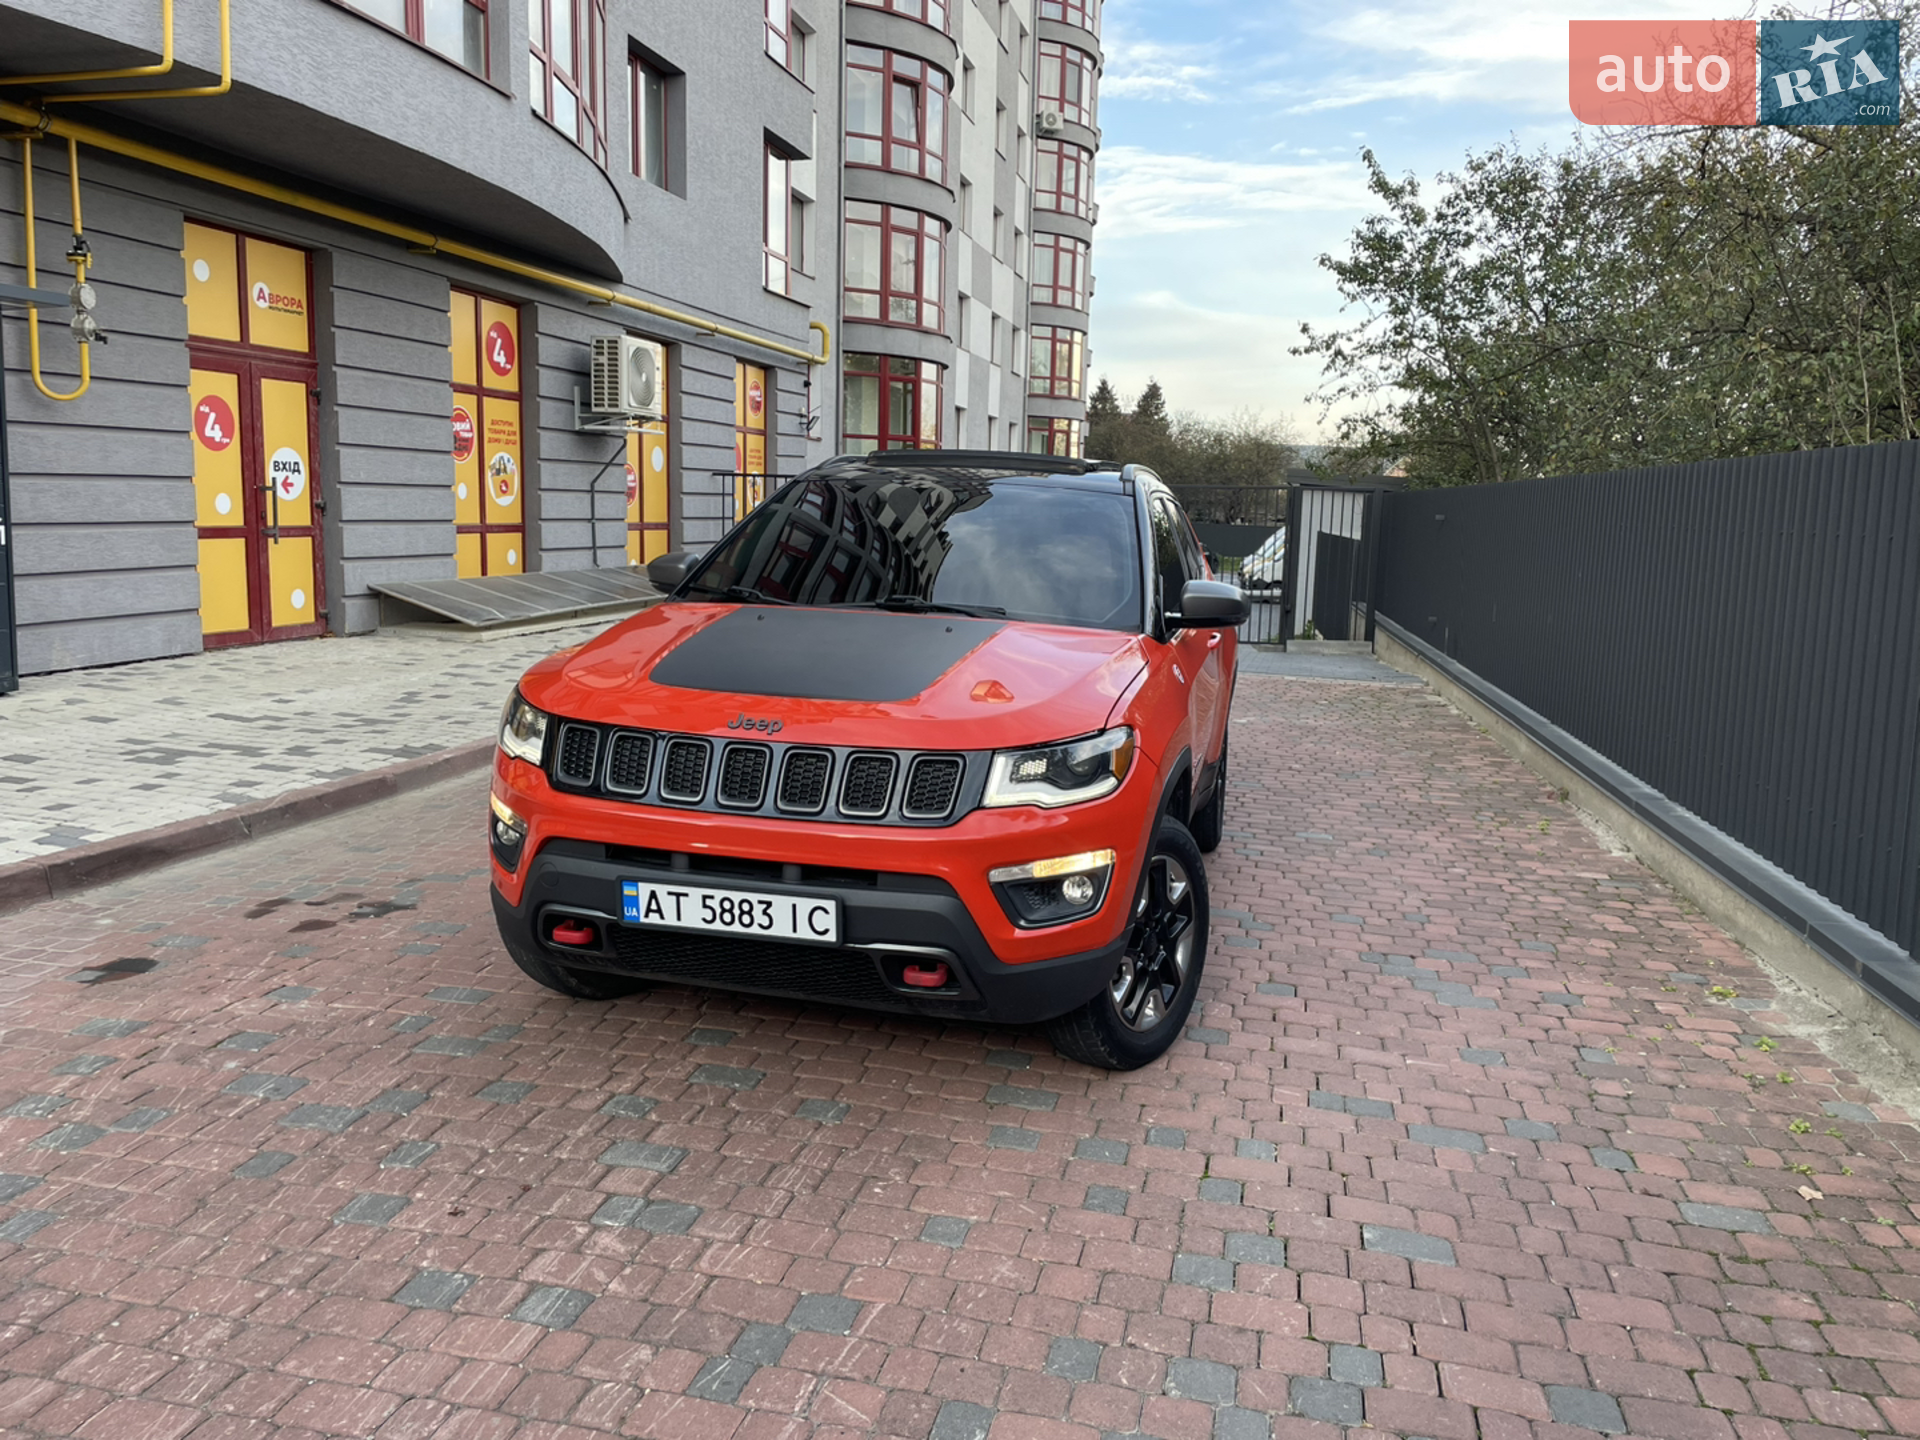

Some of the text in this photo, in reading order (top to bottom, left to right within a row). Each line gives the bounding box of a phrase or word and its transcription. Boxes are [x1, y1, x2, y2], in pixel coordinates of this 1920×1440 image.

[256, 287, 304, 310] АВРОРА
[493, 338, 506, 367] 4
[204, 412, 222, 442] 4
[273, 460, 301, 475] ВХІД
[728, 712, 782, 735] Jeep
[624, 906, 638, 917] UA
[644, 890, 830, 936] AT 5883 IC
